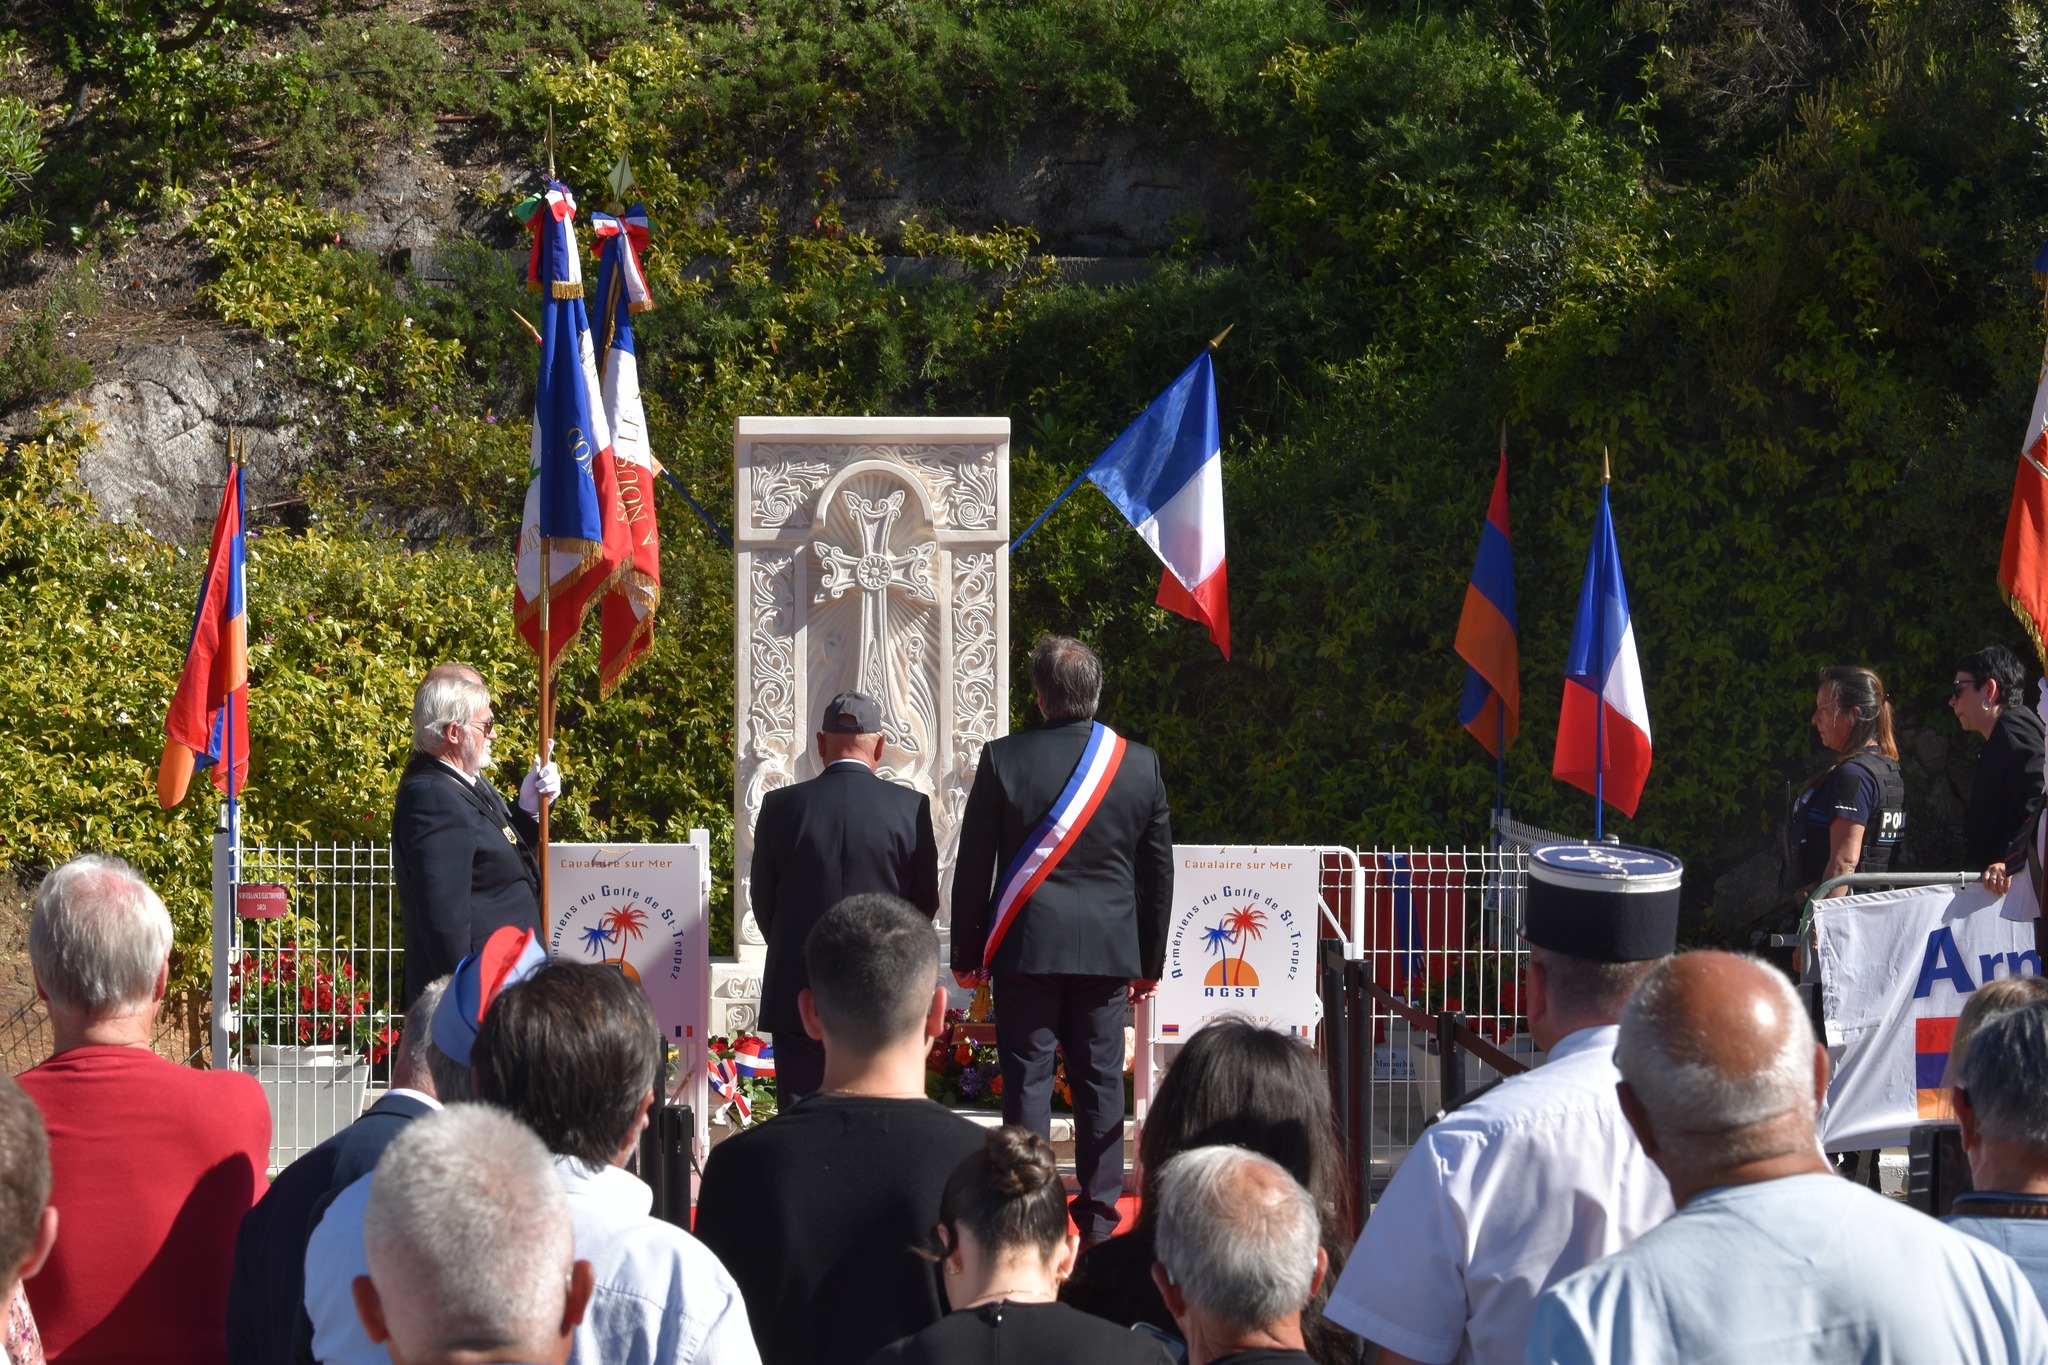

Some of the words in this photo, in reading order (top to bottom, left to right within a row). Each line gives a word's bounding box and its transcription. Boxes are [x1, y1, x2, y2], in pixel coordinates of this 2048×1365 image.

[617, 409, 642, 443] LE
[615, 454, 648, 526] NOUS
[560, 859, 620, 868] Cavalaire
[625, 860, 644, 868] sur
[649, 859, 673, 868] Mer
[1184, 859, 1242, 870] Cavalaire
[1246, 861, 1266, 870] sur
[1269, 861, 1293, 870] Mer
[550, 904, 578, 960] méniens
[580, 892, 595, 905] du
[601, 884, 640, 899] Golfe
[644, 896, 660, 909] de
[661, 908, 685, 980] St-Tropez
[1171, 905, 1200, 979] Arméniens
[1202, 893, 1218, 905] du
[1222, 885, 1261, 900] Golfe
[1264, 897, 1279, 910] de
[1280, 909, 1302, 981] St-Tropez
[728, 977, 763, 998] CA
[1204, 987, 1258, 998] AGST
[1259, 1015, 1269, 1023] 02
